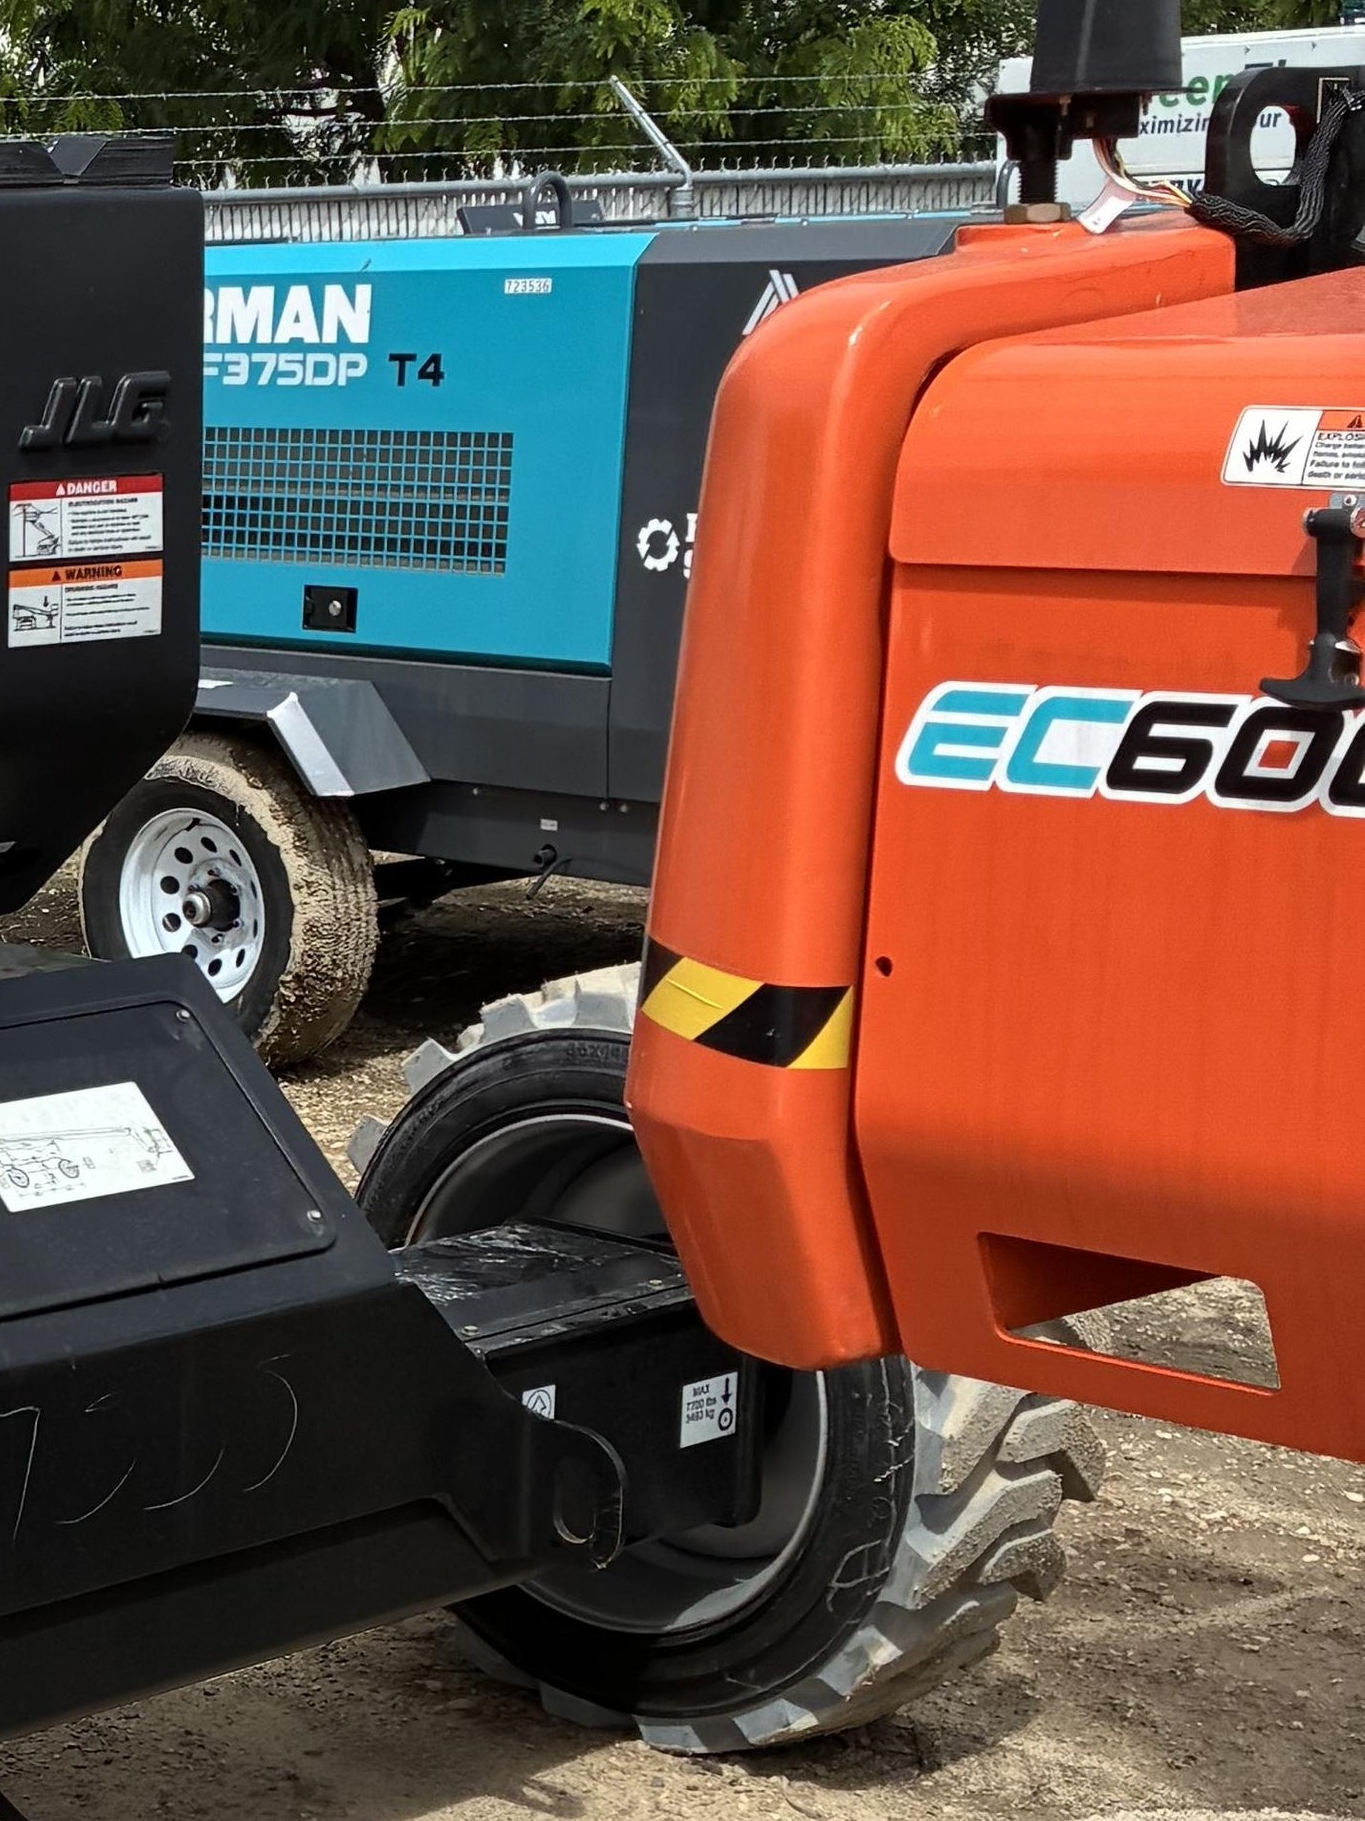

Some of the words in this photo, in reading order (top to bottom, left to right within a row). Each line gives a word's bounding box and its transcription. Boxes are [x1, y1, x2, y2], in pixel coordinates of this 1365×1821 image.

[388, 352, 445, 387] T4
[19, 371, 171, 451] JLG
[67, 479, 117, 495] DANGER
[65, 565, 122, 581] WARNING
